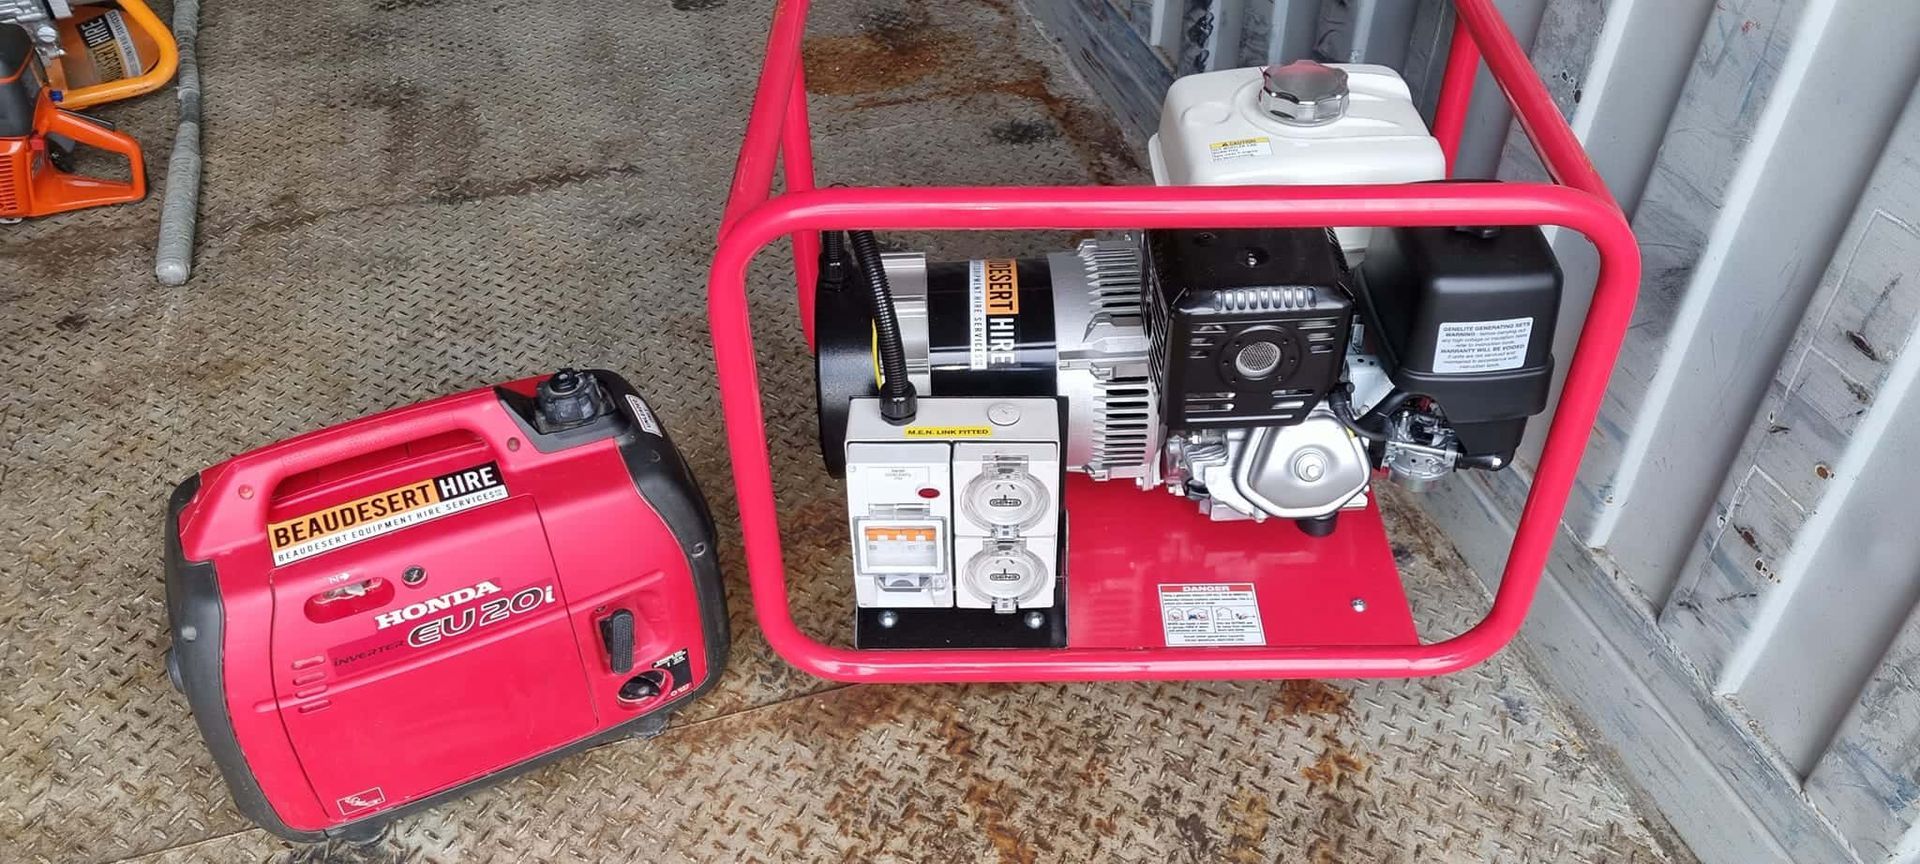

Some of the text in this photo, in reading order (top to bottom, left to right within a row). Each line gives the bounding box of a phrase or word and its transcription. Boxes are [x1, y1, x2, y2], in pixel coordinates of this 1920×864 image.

[80, 17, 112, 48] HIRE
[988, 260, 1015, 364] DESERT HIRE
[273, 466, 498, 548] BEAUDESERT HIRE
[278, 491, 496, 562] BEAUDESERT EQUIPMENT HIRE SERVICES
[374, 580, 502, 630] HONDA
